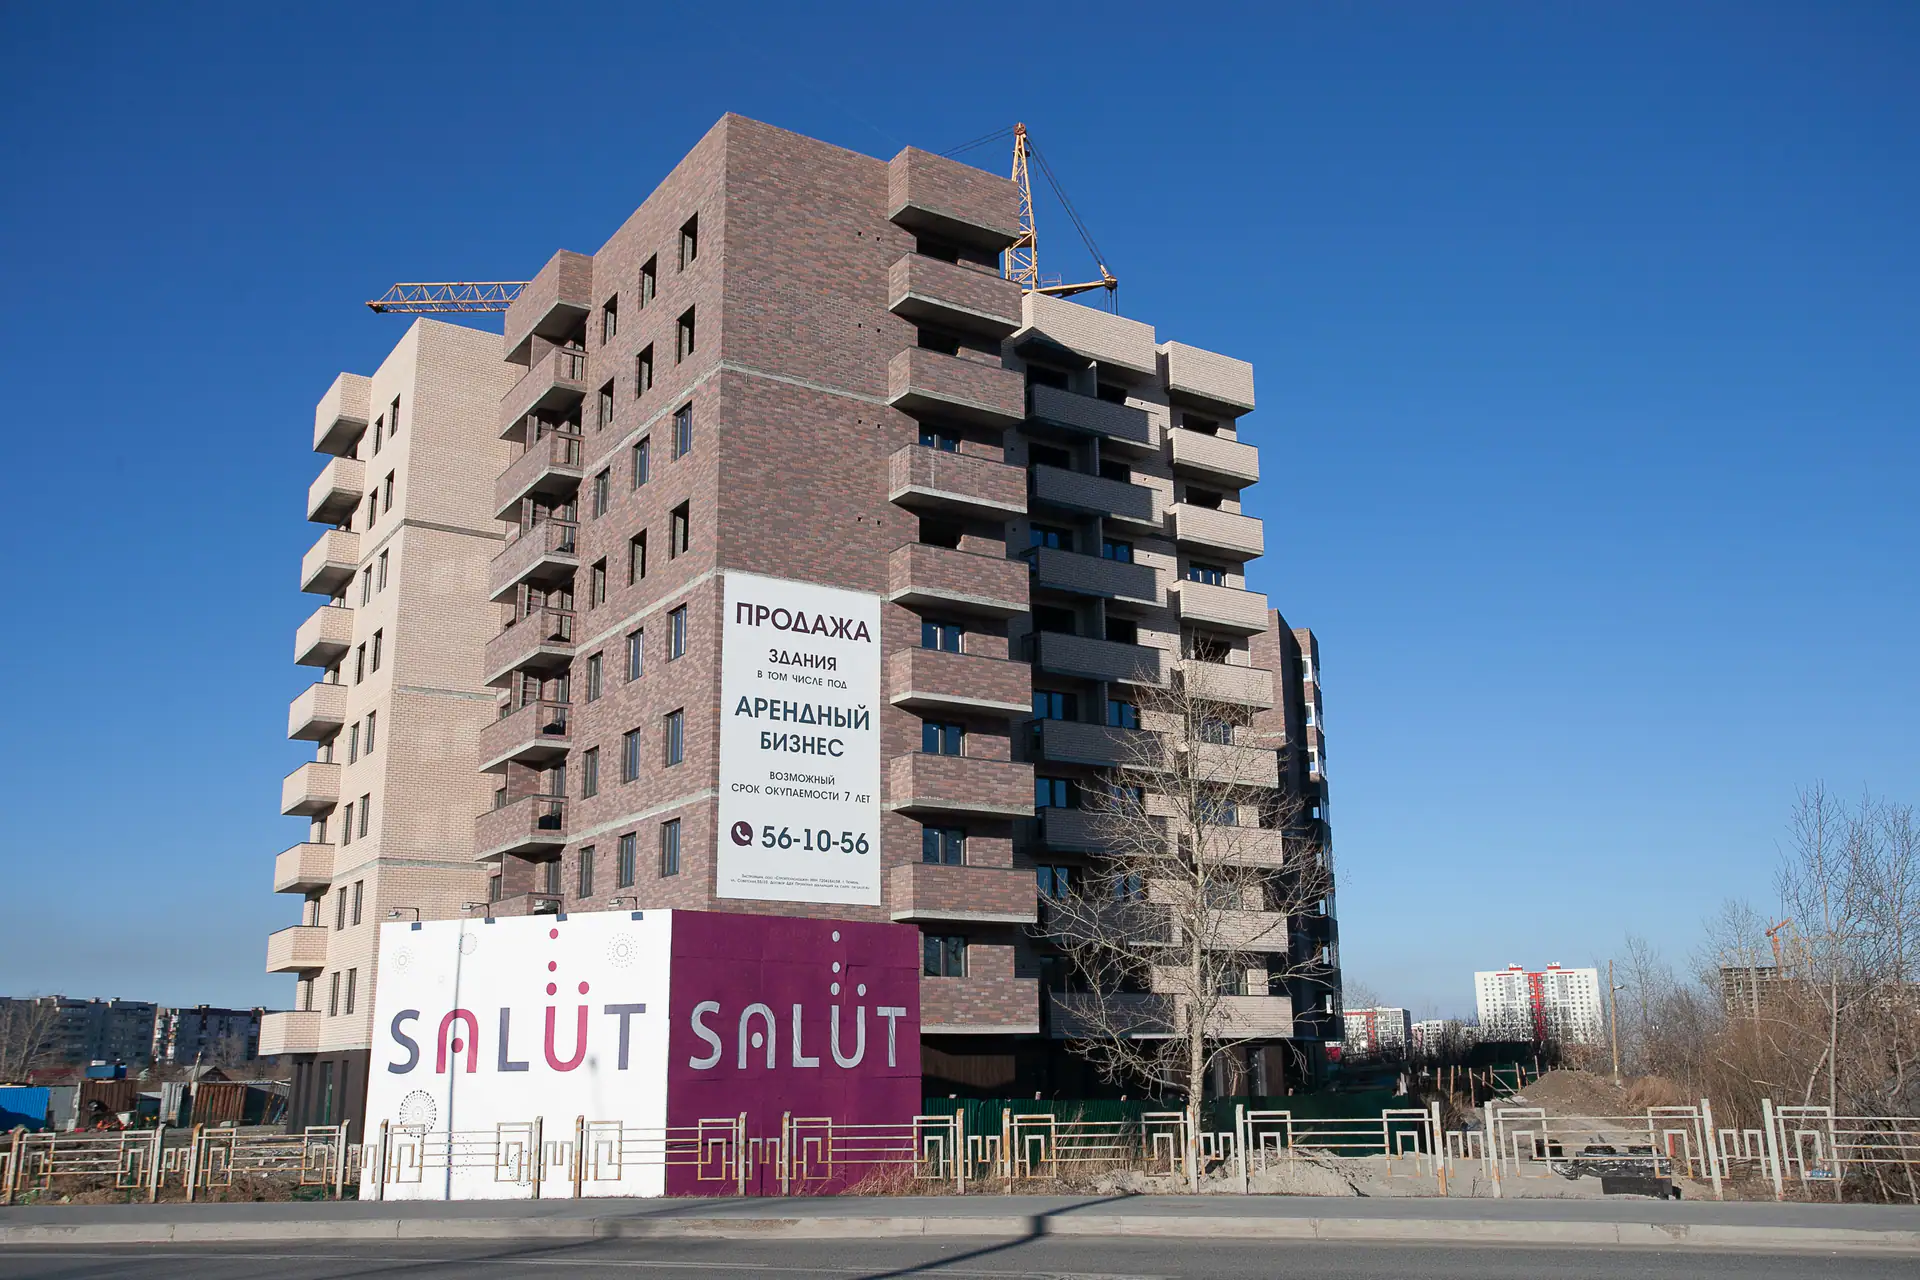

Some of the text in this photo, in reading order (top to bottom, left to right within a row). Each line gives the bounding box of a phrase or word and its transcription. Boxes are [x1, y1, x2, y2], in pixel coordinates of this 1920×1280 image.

[736, 601, 872, 643] ПРОДАЖА
[768, 648, 837, 671] ЗДАНИЯ
[757, 670, 848, 689] В ТОМ ЧИСЛЕ ПОД
[734, 695, 870, 731] АРЕНДНЫЙ
[760, 731, 844, 757] БИЗНЕС
[769, 771, 835, 786] ВОЗМОЖНЫЙ
[731, 783, 871, 804] СРОК ОКУПАЕМОСТИ 7 ЛЕТ
[761, 825, 870, 855] 56-10-56
